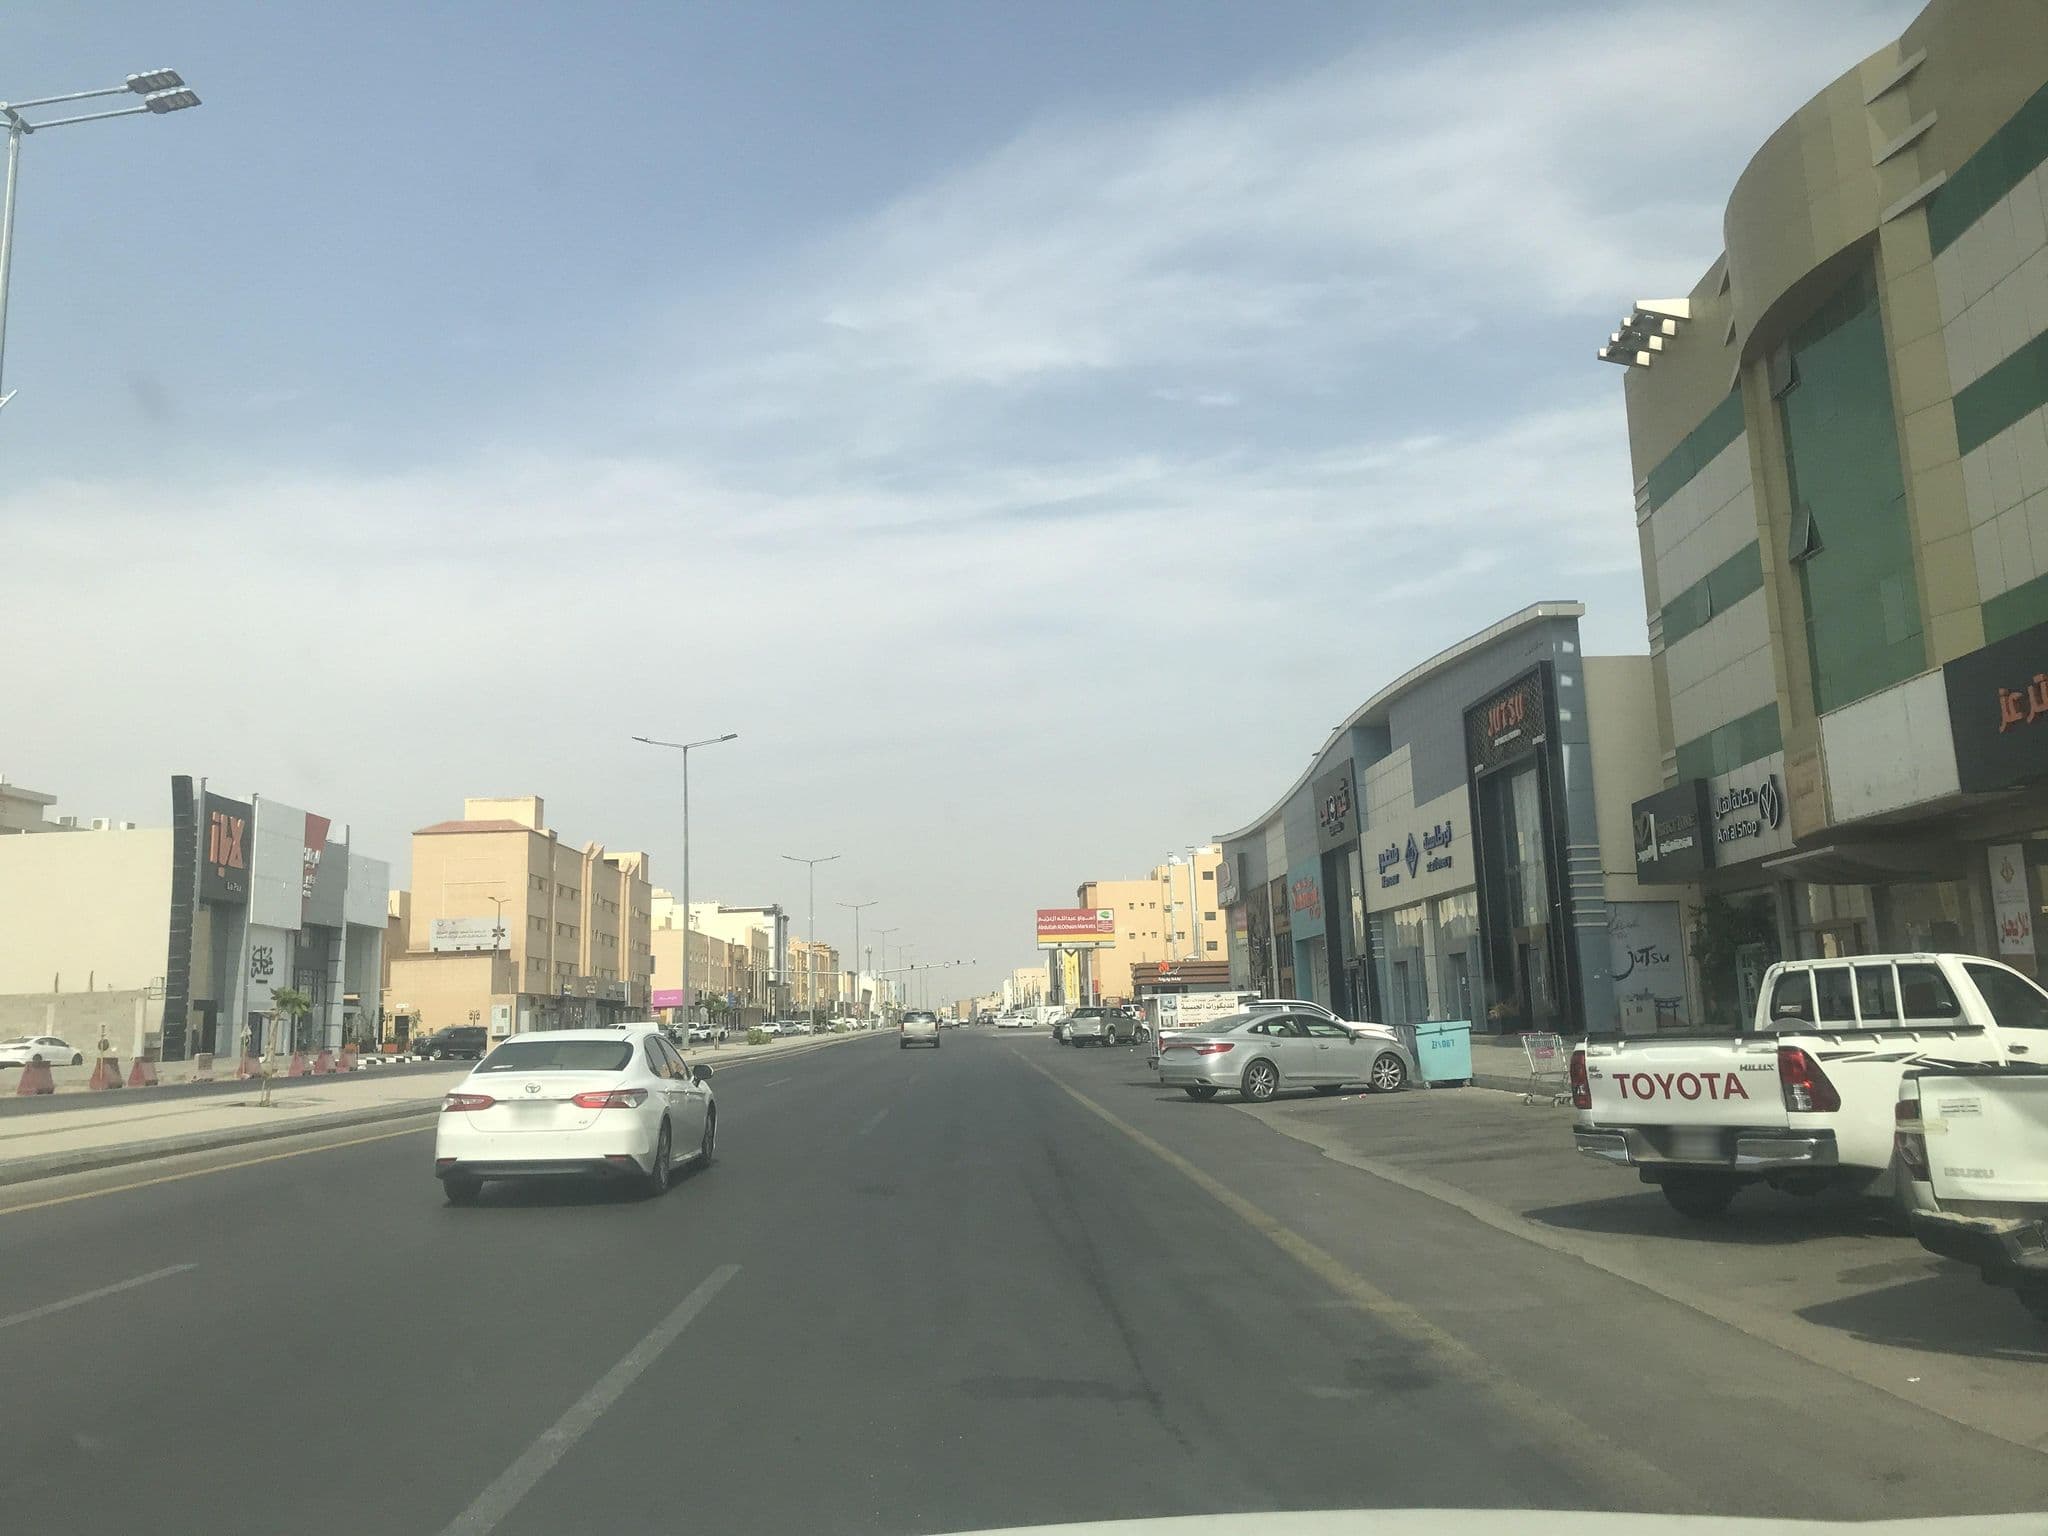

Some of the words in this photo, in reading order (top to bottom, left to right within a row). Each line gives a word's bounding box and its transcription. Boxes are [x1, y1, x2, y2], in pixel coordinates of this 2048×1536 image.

[1736, 820, 1758, 837] Shop
[1739, 1063, 1775, 1072] HILUX
[1612, 1072, 1750, 1100] TOYOTA
